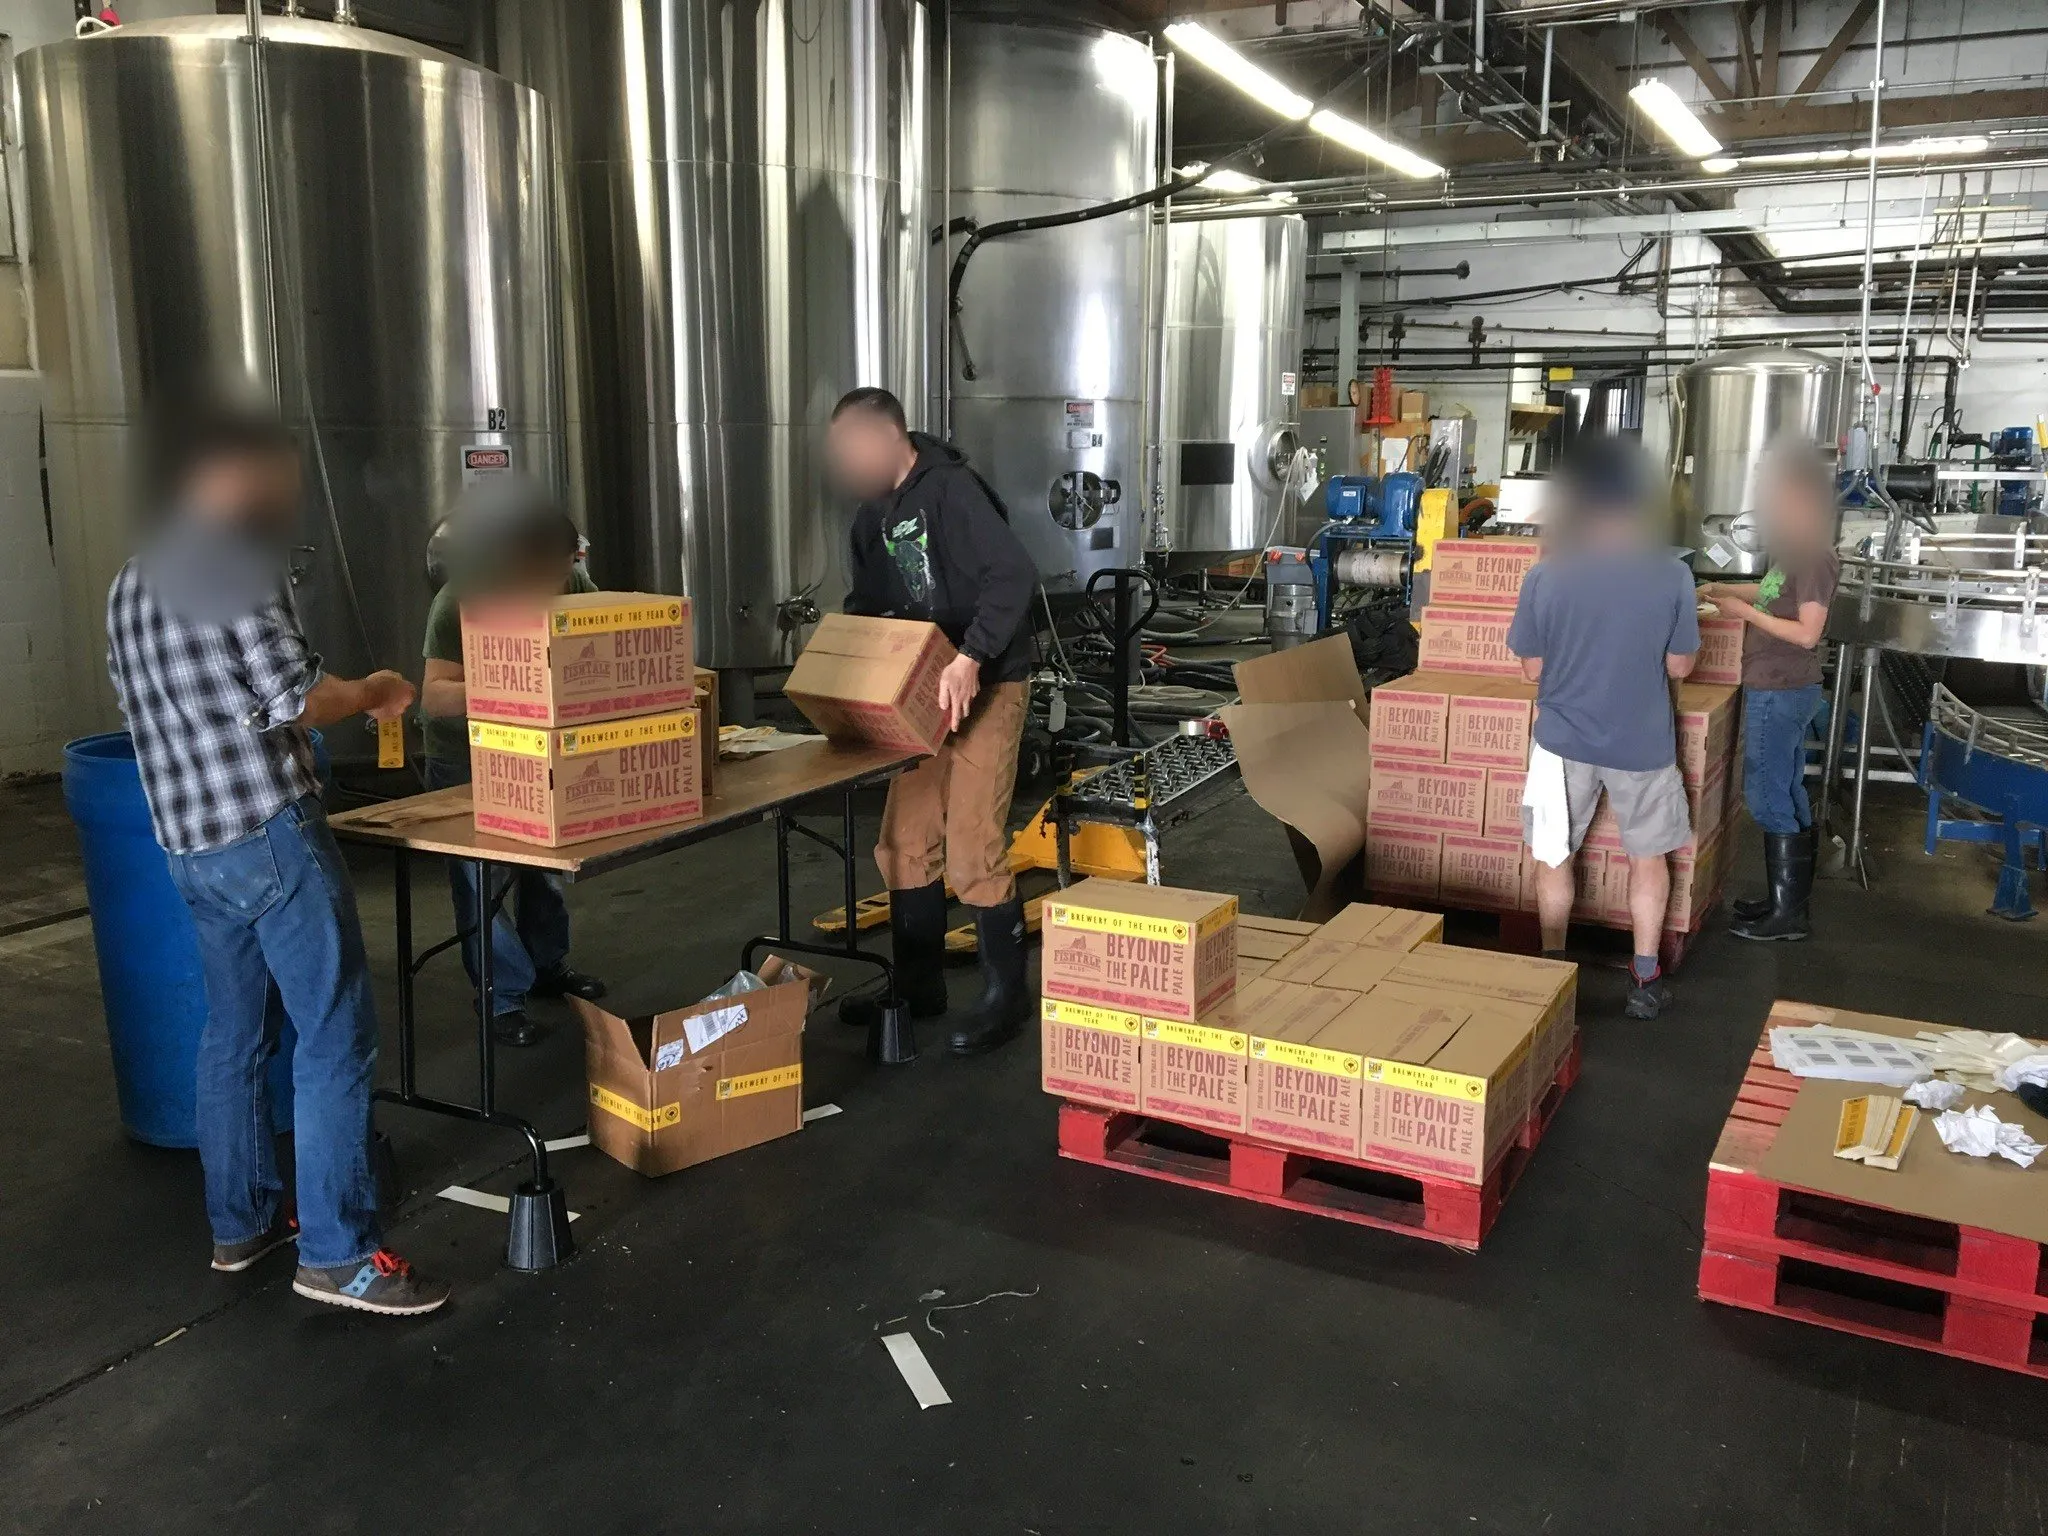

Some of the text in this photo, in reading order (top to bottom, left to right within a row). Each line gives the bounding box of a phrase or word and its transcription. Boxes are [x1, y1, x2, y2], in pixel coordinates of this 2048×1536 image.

[488, 409, 505, 430] B2
[1092, 434, 1102, 446] B4
[471, 454, 505, 464] DANGER
[1477, 557, 1521, 574] BEYOND
[1476, 575, 1519, 591] THE PALE
[573, 610, 664, 627] BREWERY OF THE YEAR
[615, 626, 672, 658] BEYOND
[1467, 626, 1509, 642] BEYON
[483, 635, 531, 662] BEYOND
[675, 625, 684, 680] PALE ALE
[1466, 643, 1480, 655] THE
[1700, 651, 1726, 666] PALE
[484, 664, 531, 692] THE PALE
[534, 667, 543, 693] PALE
[616, 655, 672, 685] THE PALE
[1389, 707, 1431, 725] BEYOND
[1469, 715, 1513, 732] BEYOND
[581, 723, 676, 744] BREWERY OF THE YEAR
[1388, 725, 1428, 741] THE PALE
[1431, 728, 1439, 742] PALE
[1468, 731, 1511, 750] THE PALE
[1513, 718, 1522, 750] PALE ALE
[620, 740, 680, 774] BEYOND
[490, 753, 534, 783] BEYOND
[621, 768, 679, 800] THE PALE
[684, 765, 692, 793] PALE
[1418, 778, 1467, 798] BEYOND
[491, 781, 534, 811] THE PALE
[1417, 796, 1464, 817] THE PALE
[1467, 782, 1476, 818] PALE ALE
[1506, 806, 1520, 817] THE
[1383, 844, 1425, 862] BEYOND
[1461, 853, 1505, 870] BEYOND
[1383, 861, 1425, 879] THE PALE
[1506, 858, 1514, 870] ALE
[1461, 870, 1503, 888] THE PALE
[1071, 913, 1107, 925] BREWERY
[1129, 921, 1142, 930] THE
[1148, 925, 1168, 933] YEAR
[1107, 934, 1170, 965] BEYOND
[1106, 961, 1168, 992] THE PALE
[1173, 944, 1183, 995] PALE ALE
[1066, 1007, 1092, 1016] BREWERY
[1065, 1028, 1120, 1057] BEYOND
[1167, 1025, 1195, 1034] BREWERY
[1211, 1032, 1222, 1040] THE
[1122, 1038, 1131, 1083] PALE ALE
[1167, 1047, 1225, 1076] BEYOND
[1276, 1046, 1306, 1056] BREWERY
[1324, 1054, 1335, 1062] THE
[1297, 1057, 1313, 1065] YEAR
[1065, 1052, 1118, 1080] THE PALE
[1393, 1067, 1425, 1078] BREWERY
[1445, 1077, 1457, 1085] THE
[735, 1078, 768, 1090] BREWERY
[786, 1071, 798, 1079] THE
[1167, 1071, 1224, 1102] THE PALE
[1228, 1057, 1237, 1104] PALE ALE
[1275, 1066, 1338, 1098] BEYOND
[1417, 1080, 1433, 1088] YEAR
[601, 1094, 622, 1109] BREWERY
[625, 1107, 631, 1115] OF
[634, 1111, 642, 1121] THE
[1275, 1091, 1335, 1123] THE PALE
[1340, 1077, 1350, 1127] PALE ALE
[1393, 1092, 1460, 1125] BEYOND
[1392, 1117, 1457, 1152] THE PALE
[1461, 1106, 1474, 1155] PALE ALE
